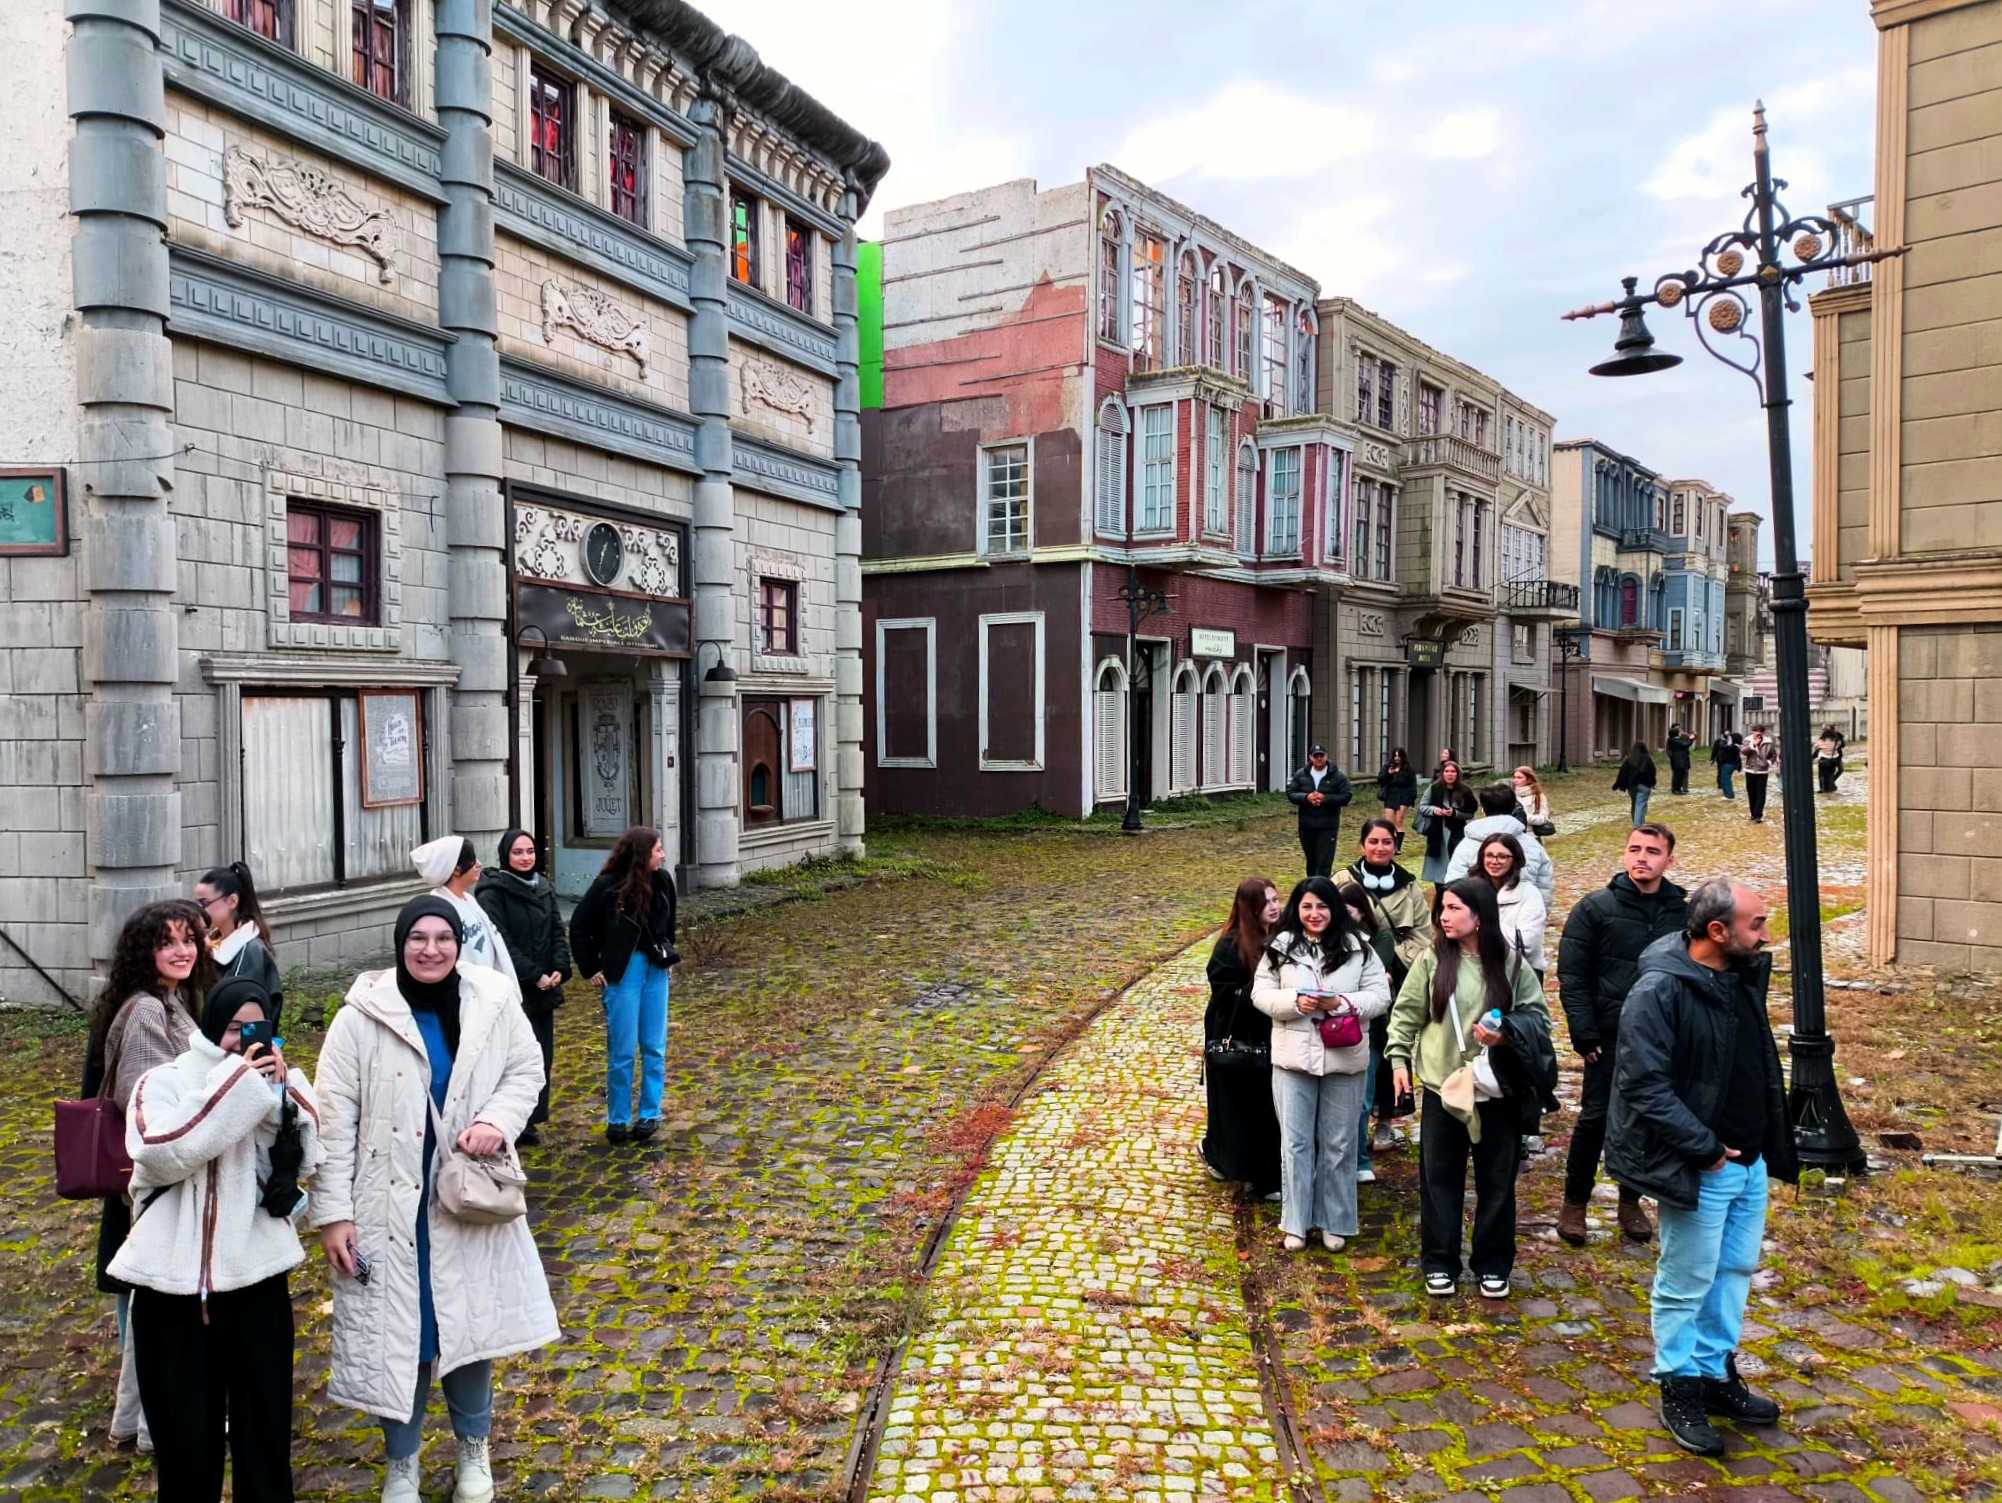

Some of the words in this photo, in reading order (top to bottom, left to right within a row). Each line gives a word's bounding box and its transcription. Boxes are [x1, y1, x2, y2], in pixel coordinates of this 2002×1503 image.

[560, 635, 588, 643] BANQUE
[589, 638, 624, 646] IMPERIALE
[593, 696, 619, 713] ROMEO
[596, 795, 622, 815] JULIET
